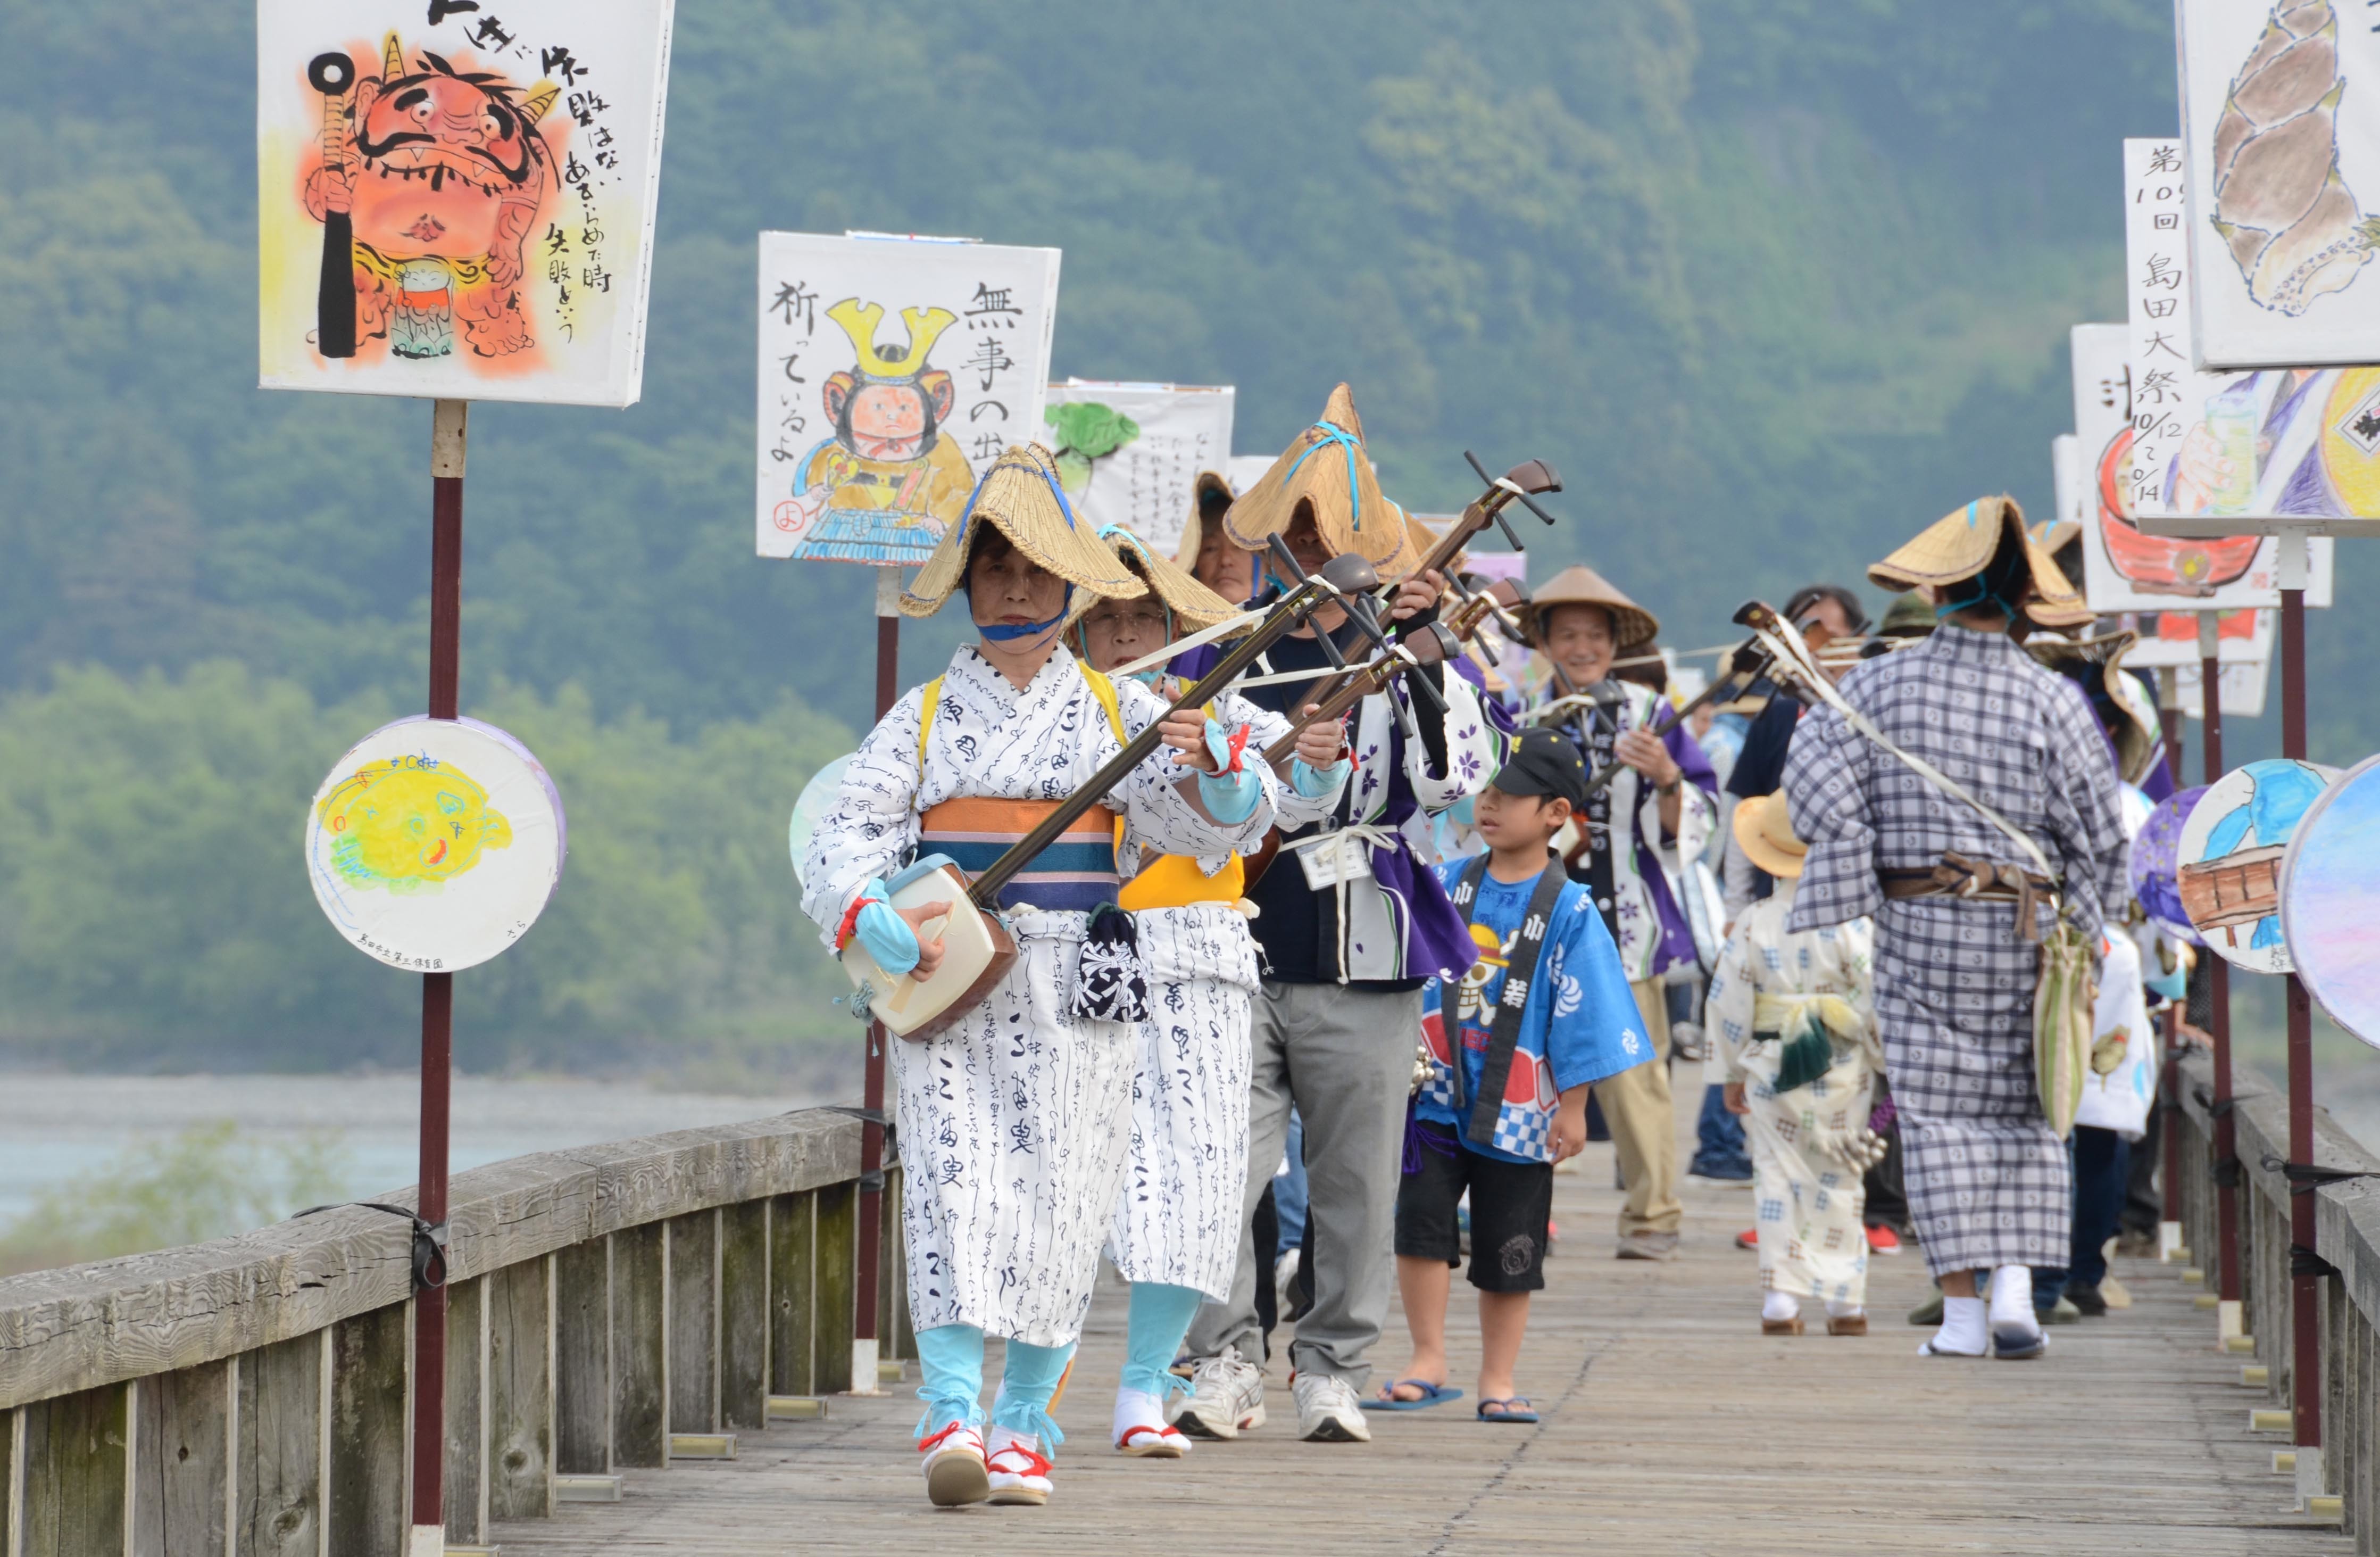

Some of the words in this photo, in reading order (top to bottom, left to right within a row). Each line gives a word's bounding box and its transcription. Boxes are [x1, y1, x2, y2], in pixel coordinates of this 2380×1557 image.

[769, 281, 819, 462] 祈っているよ
[960, 282, 1023, 462] 無事の出
